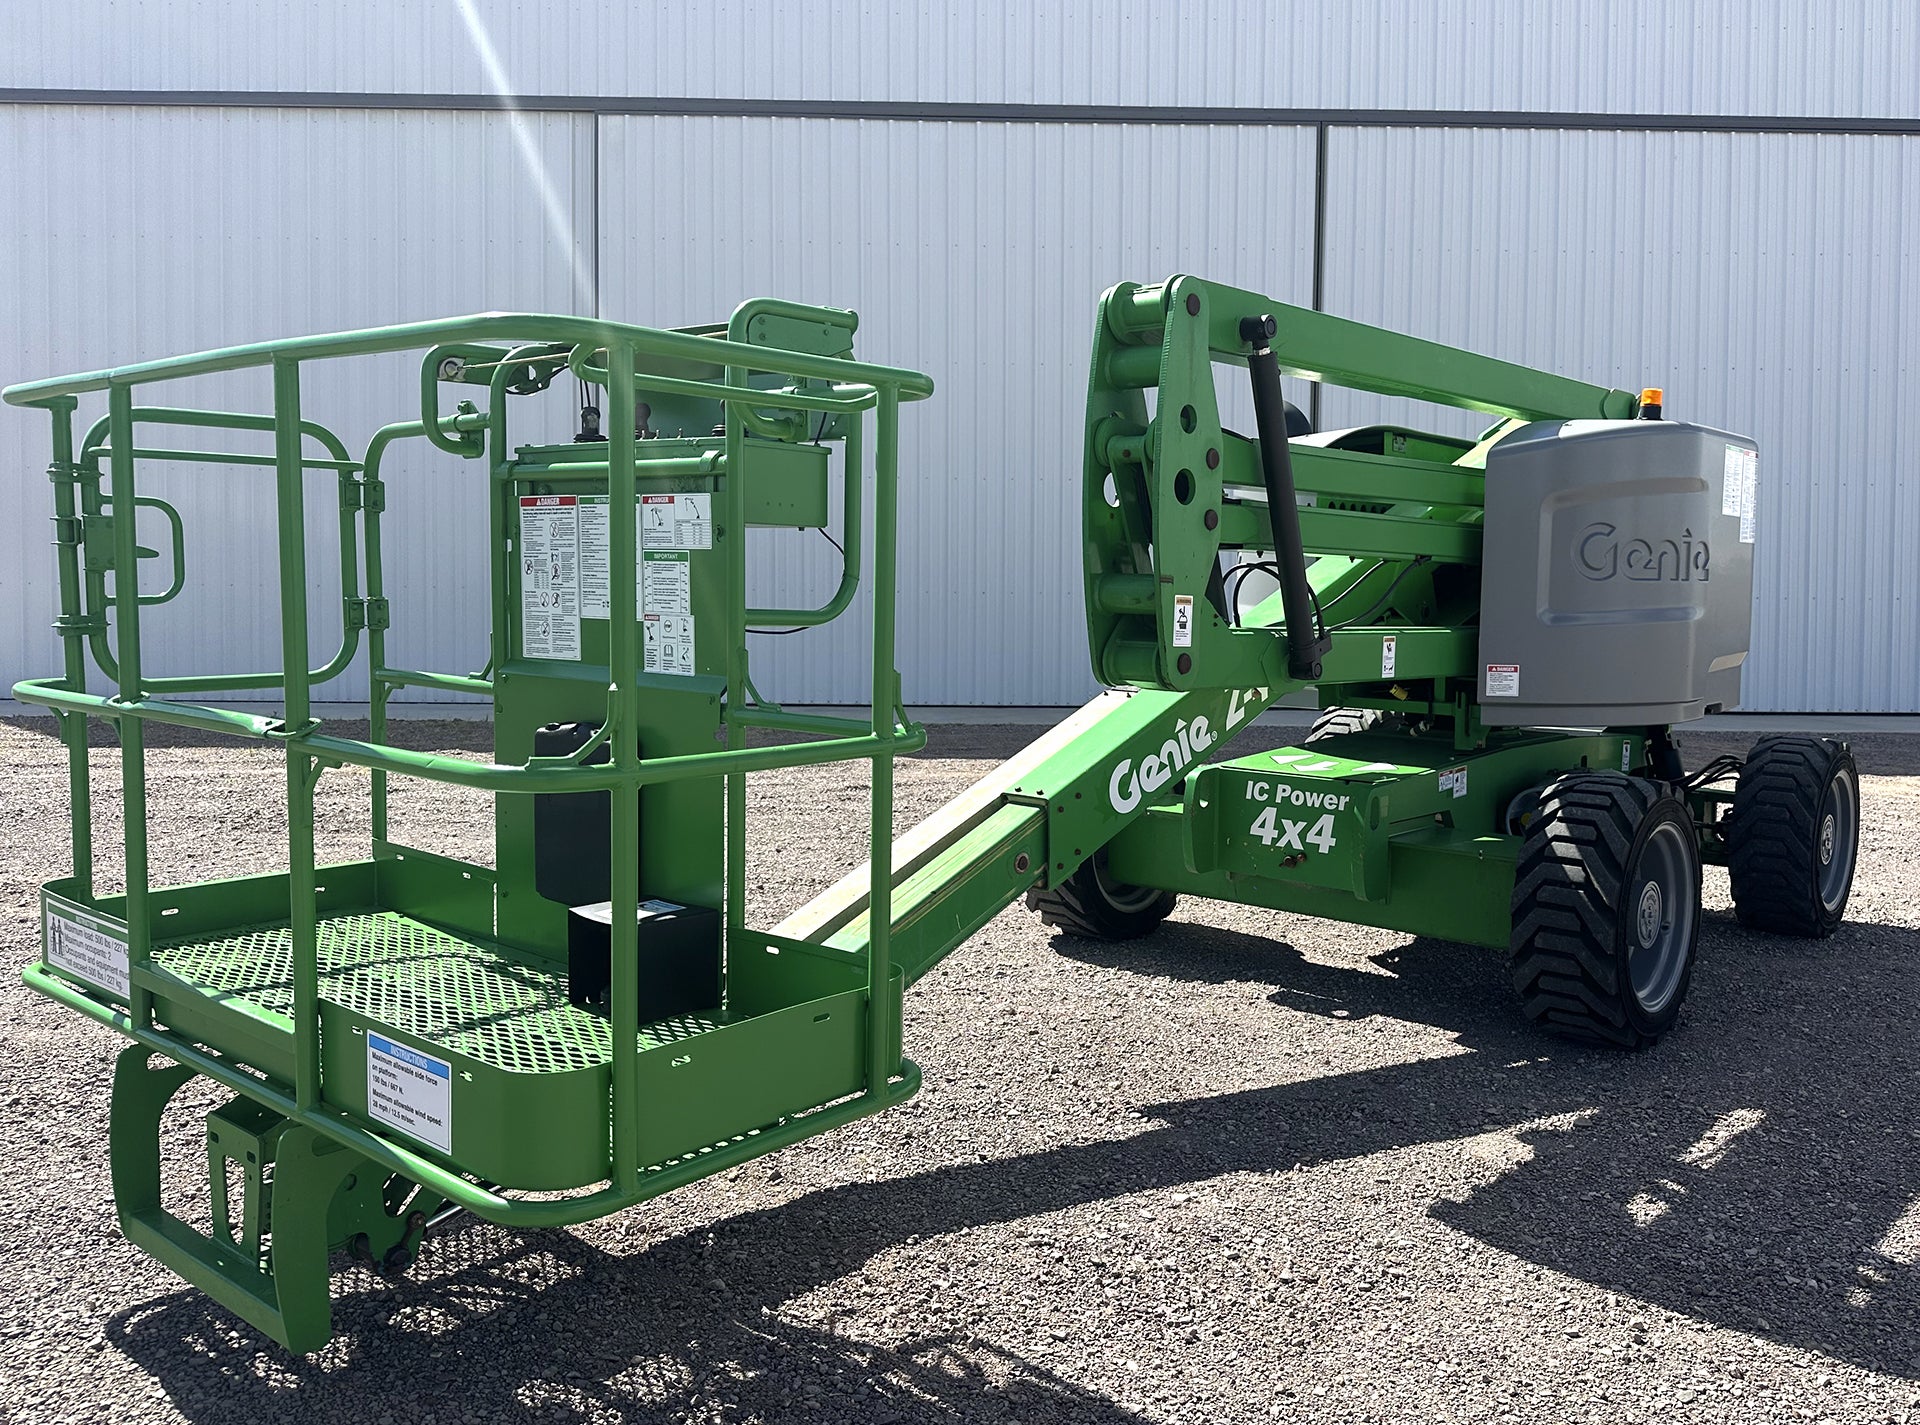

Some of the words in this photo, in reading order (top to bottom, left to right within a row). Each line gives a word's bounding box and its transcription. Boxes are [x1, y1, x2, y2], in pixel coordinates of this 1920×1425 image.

[1570, 521, 1710, 582] Genie
[1109, 715, 1213, 814] Genie
[1245, 780, 1270, 802] IC
[1276, 784, 1350, 811] Power
[1250, 806, 1337, 854] 4x4
[372, 1051, 393, 1067] Maximum
[393, 1061, 414, 1076] allowable
[415, 1071, 425, 1081] side
[425, 1075, 438, 1087] force
[390, 1044, 428, 1070] INSTRUCTIONS
[372, 1088, 393, 1104] Maximum
[393, 1097, 414, 1114] allowable
[415, 1108, 426, 1120] wind
[379, 1103, 389, 1114] mph
